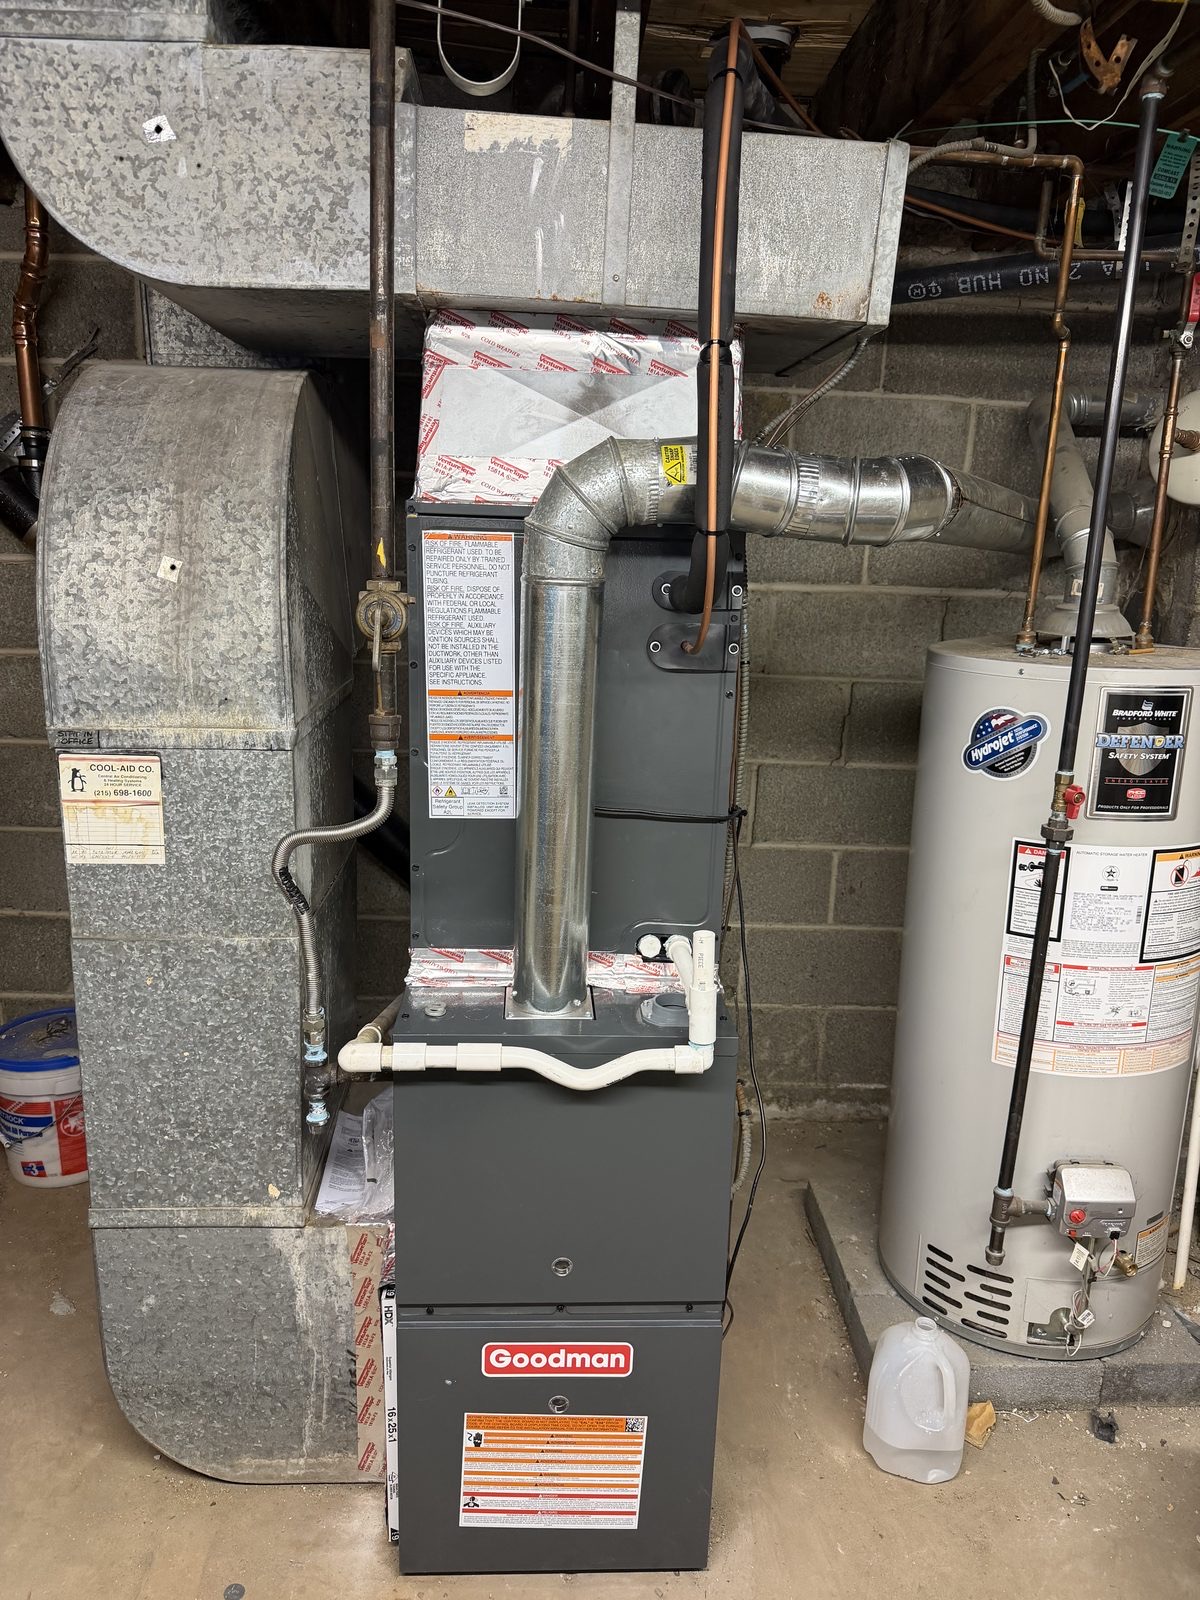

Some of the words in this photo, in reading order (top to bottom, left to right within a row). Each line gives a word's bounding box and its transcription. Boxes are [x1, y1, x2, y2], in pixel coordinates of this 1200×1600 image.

[958, 272, 1001, 294] HUB
[1020, 266, 1049, 286] NO
[481, 336, 496, 348] COLD
[496, 343, 520, 358] WEATHER
[437, 455, 476, 476] VentureTape
[487, 466, 504, 478] 1581A
[490, 457, 529, 480] VentureTape
[481, 481, 496, 492] COLD
[971, 730, 1014, 762] Hydrojet
[1097, 734, 1184, 749] DEFENDER
[90, 764, 135, 772] COOL-AID
[29, 1163, 38, 1175] 3
[384, 1306, 394, 1325] HDX
[489, 1348, 625, 1368] Goodman
